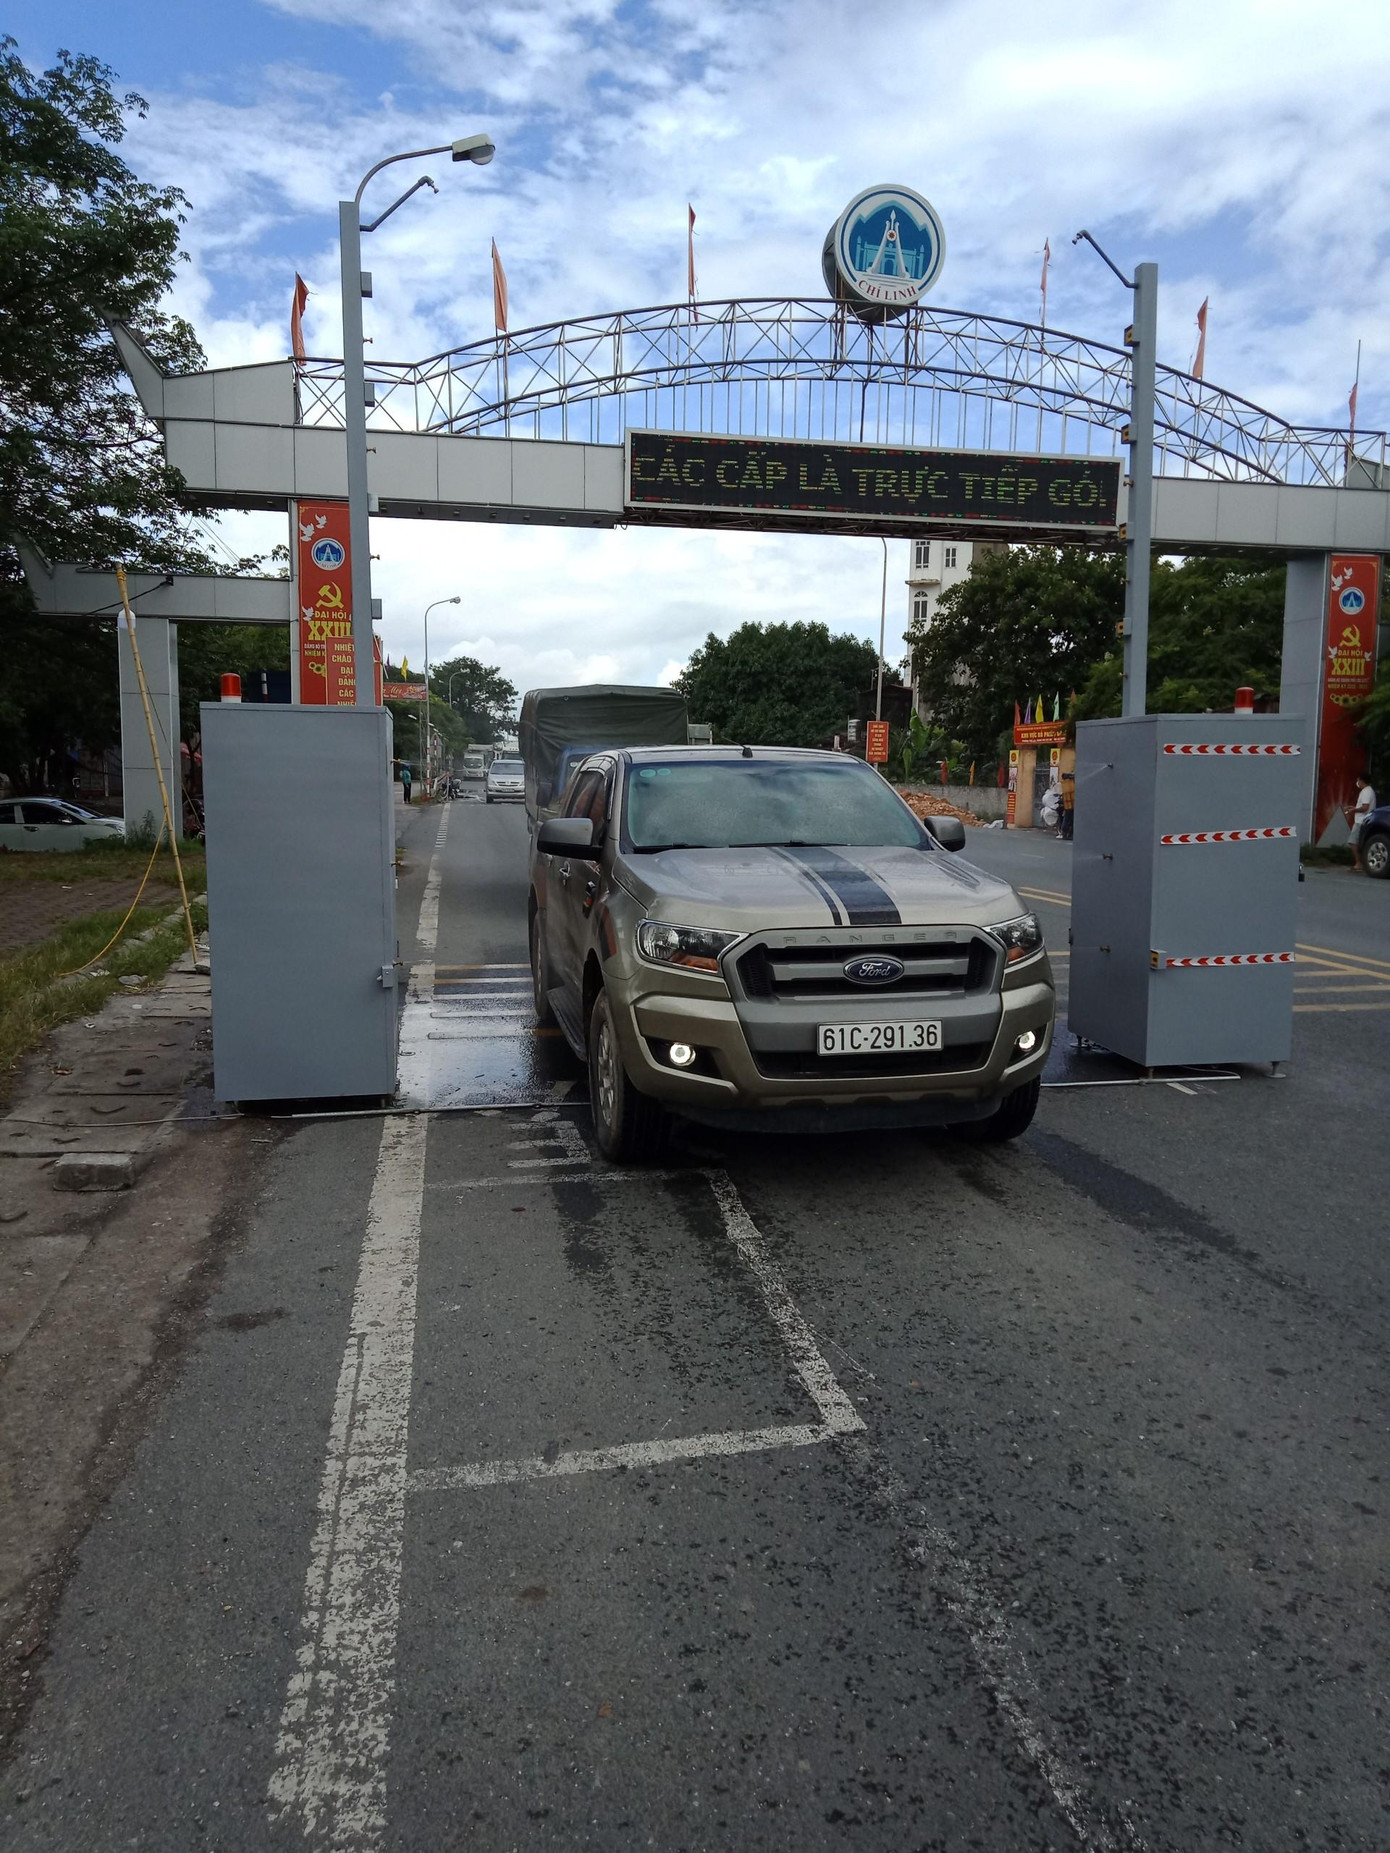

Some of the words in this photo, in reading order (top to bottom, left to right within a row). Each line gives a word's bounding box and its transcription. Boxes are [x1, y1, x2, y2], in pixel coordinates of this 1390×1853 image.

[884, 285, 917, 301] LINH
[632, 444, 705, 486] CÁC
[715, 450, 788, 490] CẤP
[798, 454, 842, 495] LÀ
[851, 465, 949, 504] TRỰC
[958, 464, 1039, 504] TIẾP
[315, 611, 329, 620] ĐẠI
[332, 609, 347, 619] HỘI
[308, 621, 351, 640] XXIII
[332, 653, 352, 663] CHÀO
[341, 667, 353, 676] ĐẠI
[1332, 658, 1365, 675] XXIII
[339, 689, 354, 698] CÁC
[783, 931, 957, 944] RANGER
[859, 962, 891, 977] Ford
[823, 1024, 938, 1051] 61C-291.36
